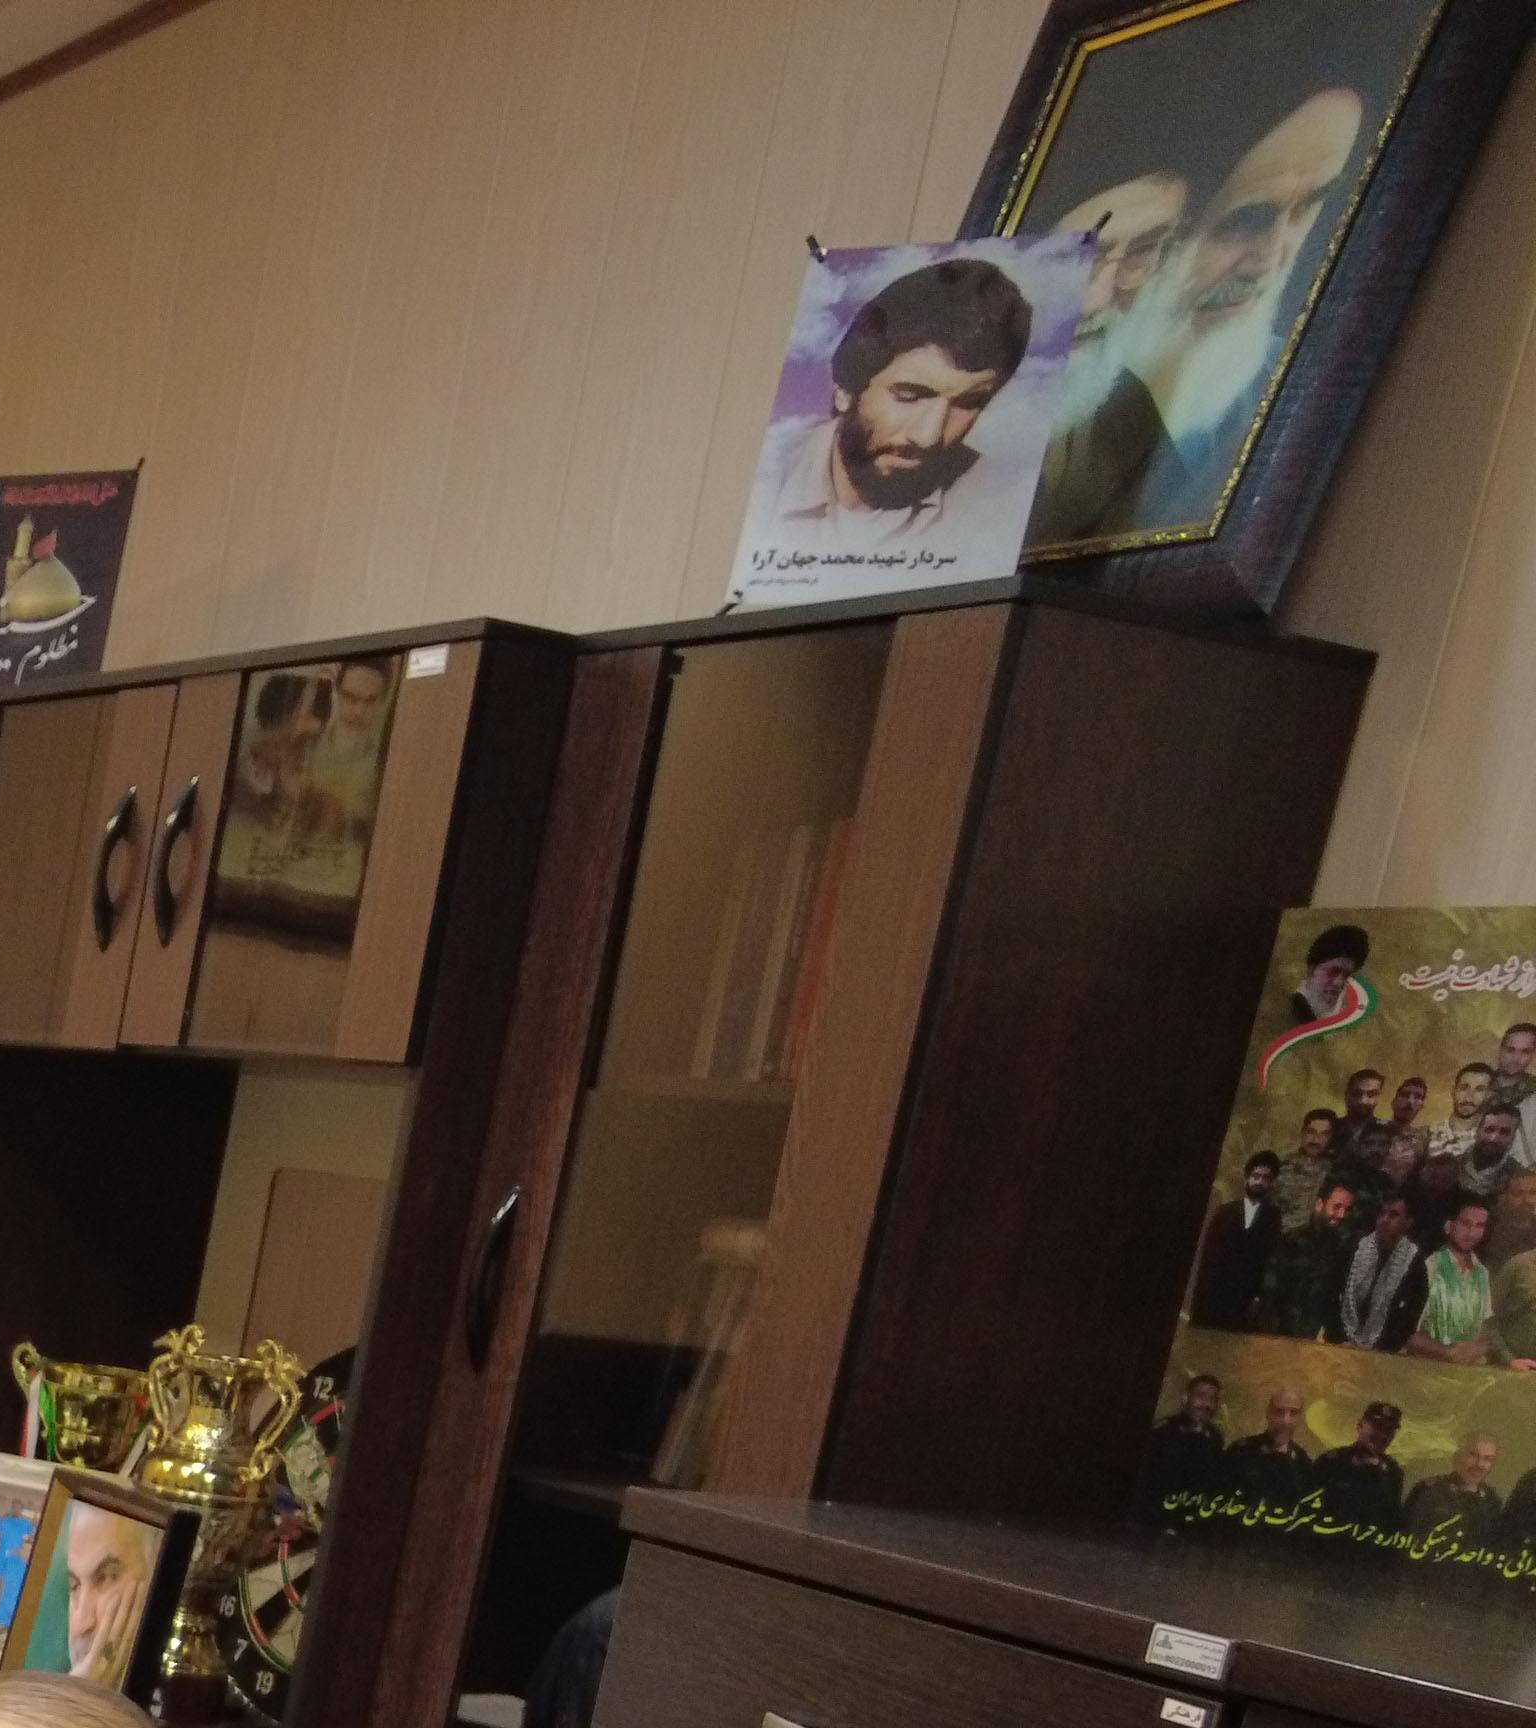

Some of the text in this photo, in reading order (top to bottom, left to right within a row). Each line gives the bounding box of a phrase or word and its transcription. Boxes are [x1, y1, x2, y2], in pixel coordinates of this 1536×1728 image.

[752, 550, 957, 570] سردار شهید محمد جهان آرا
[313, 1376, 334, 1400] 12
[1163, 1490, 1204, 1522] ایران
[1243, 1498, 1266, 1526] ملی
[1264, 1488, 1324, 1532] شرکت
[234, 1638, 249, 1661] 7
[256, 1670, 274, 1695] 19
